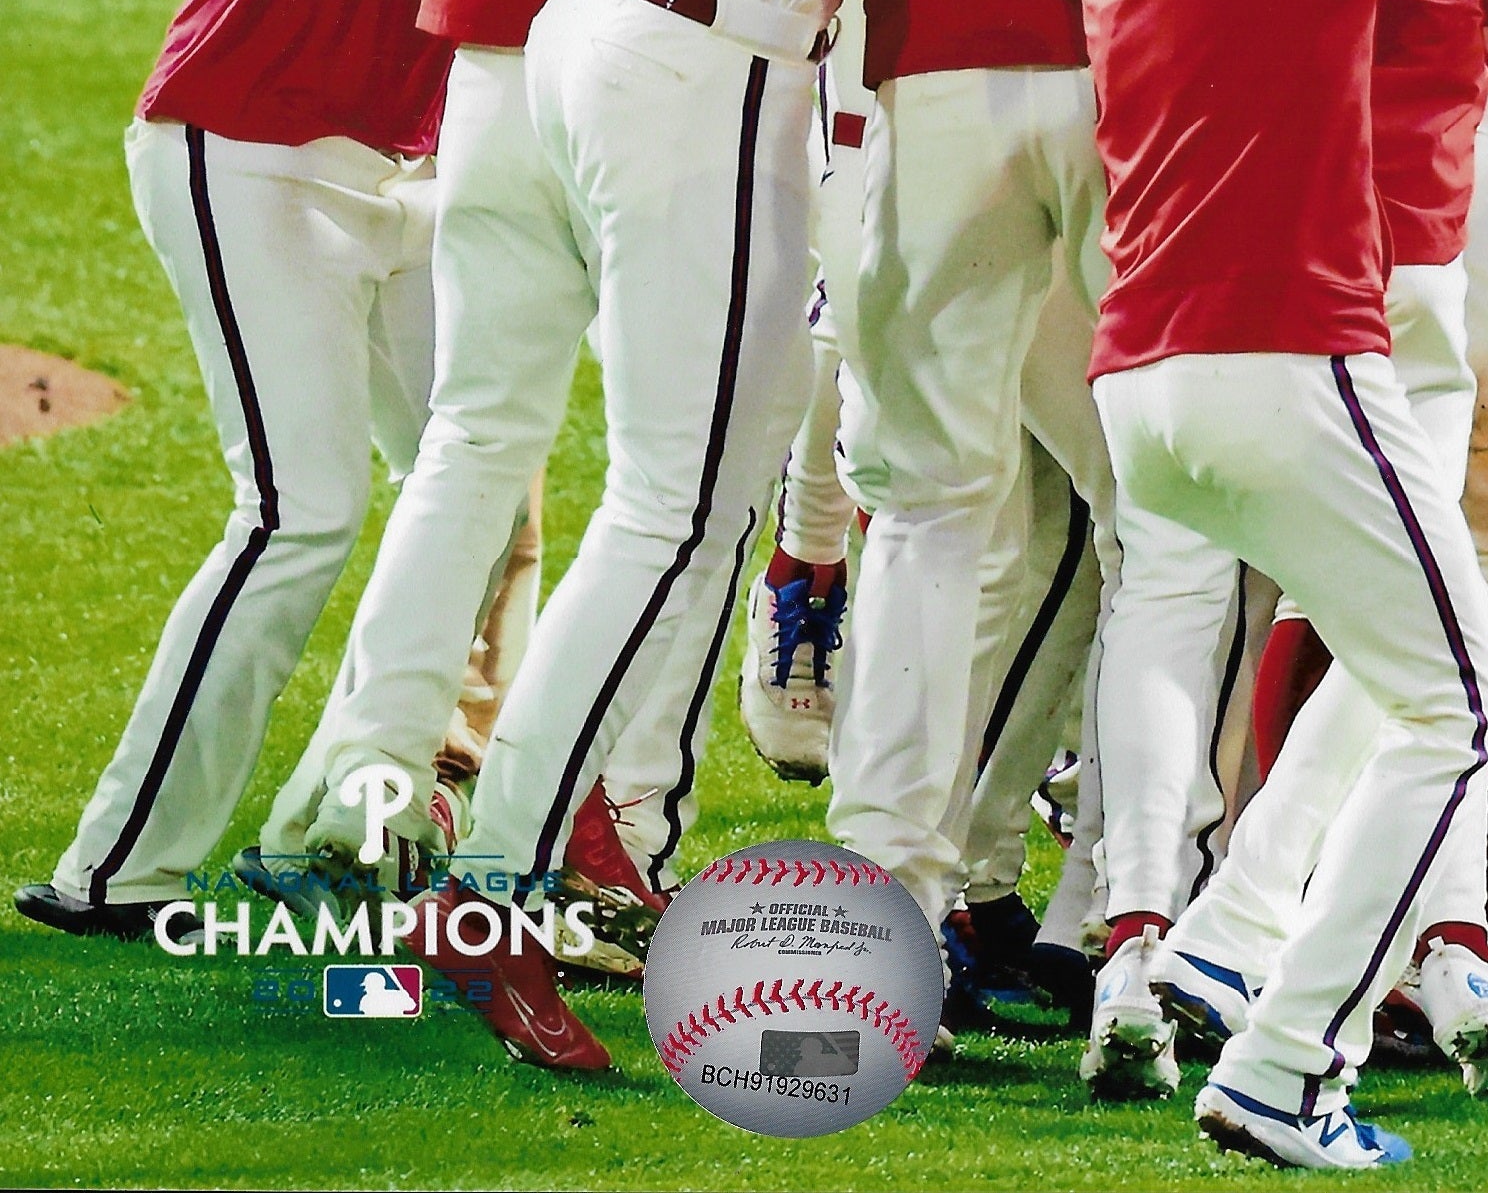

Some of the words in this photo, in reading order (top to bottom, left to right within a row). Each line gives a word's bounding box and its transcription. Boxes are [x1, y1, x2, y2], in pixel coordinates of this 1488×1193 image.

[768, 903, 829, 918] OFFICIAL
[700, 918, 757, 936] MAJOR
[760, 917, 816, 932] LEAGUE
[820, 919, 893, 943] BASEBALL
[701, 1064, 851, 1106] BCH91929631
